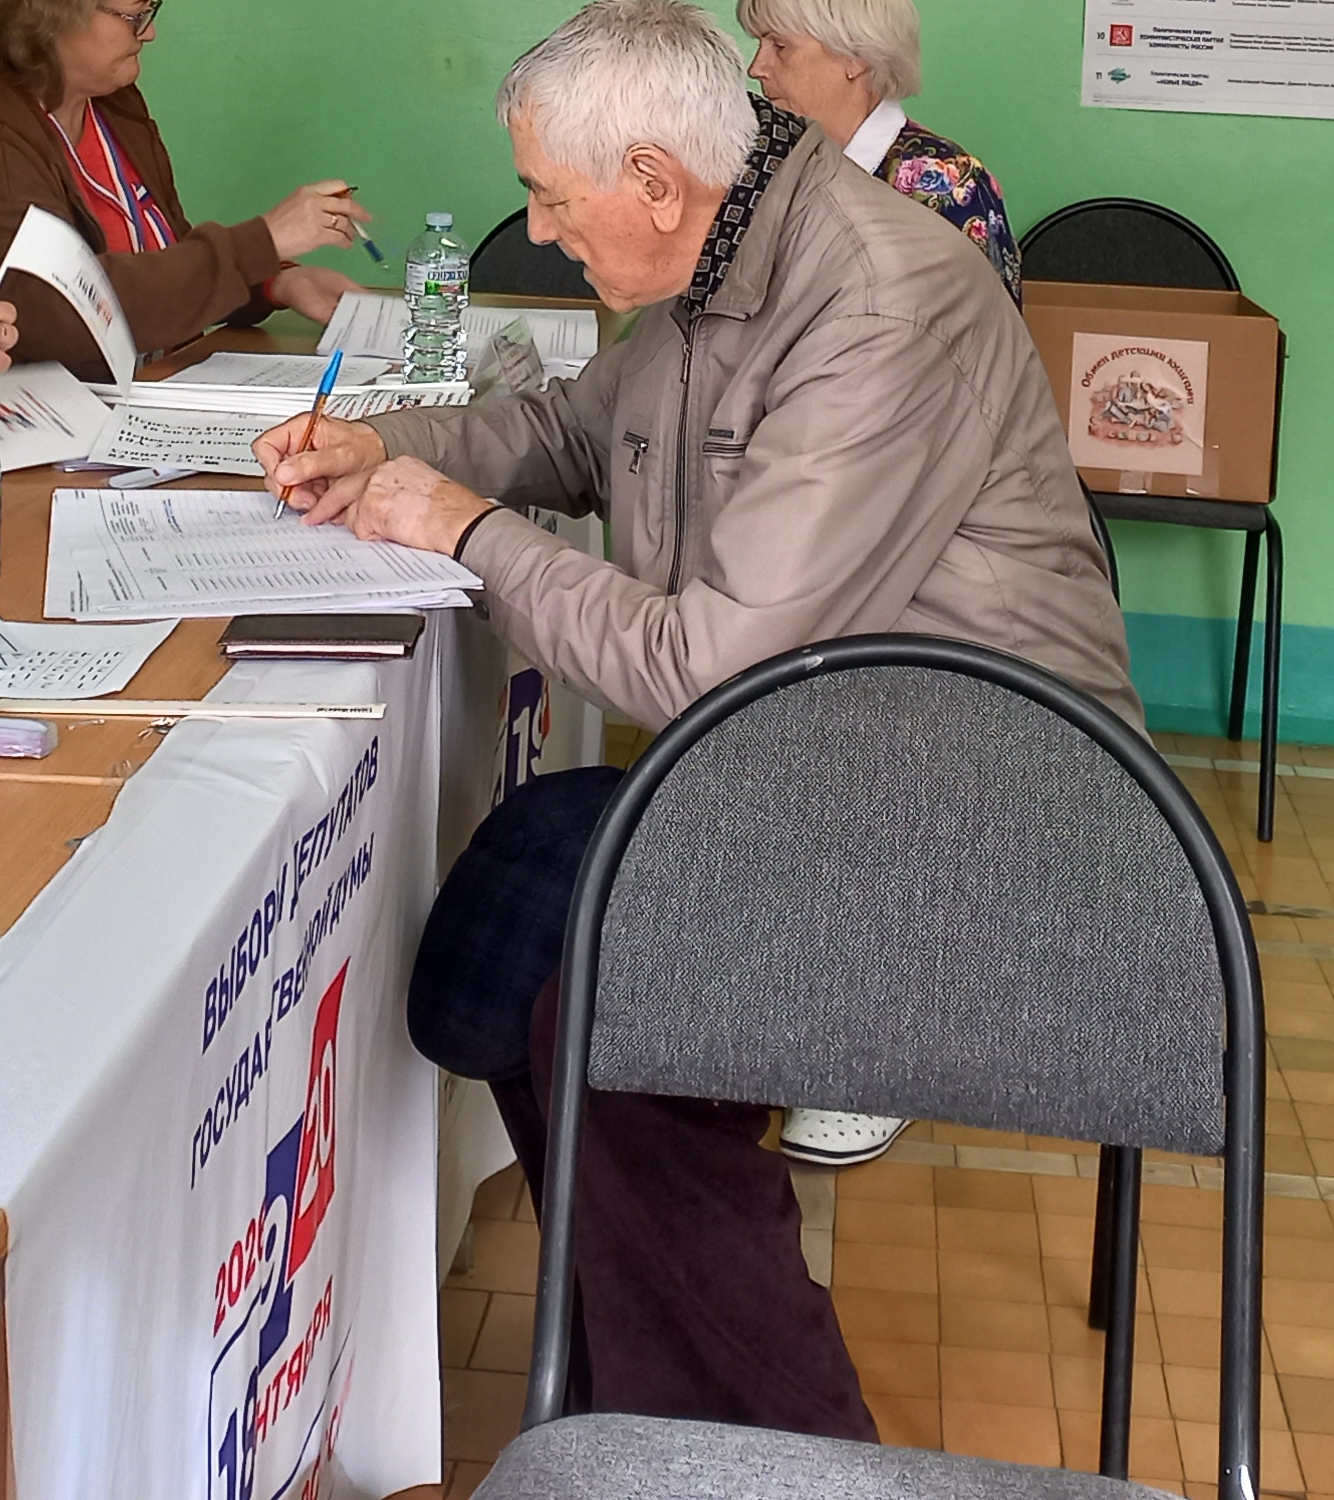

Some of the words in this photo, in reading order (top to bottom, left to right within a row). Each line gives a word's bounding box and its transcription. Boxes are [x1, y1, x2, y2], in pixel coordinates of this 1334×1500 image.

[1081, 356, 1110, 388] Обмен
[1110, 347, 1167, 362] детскими
[1167, 358, 1194, 405] книгами
